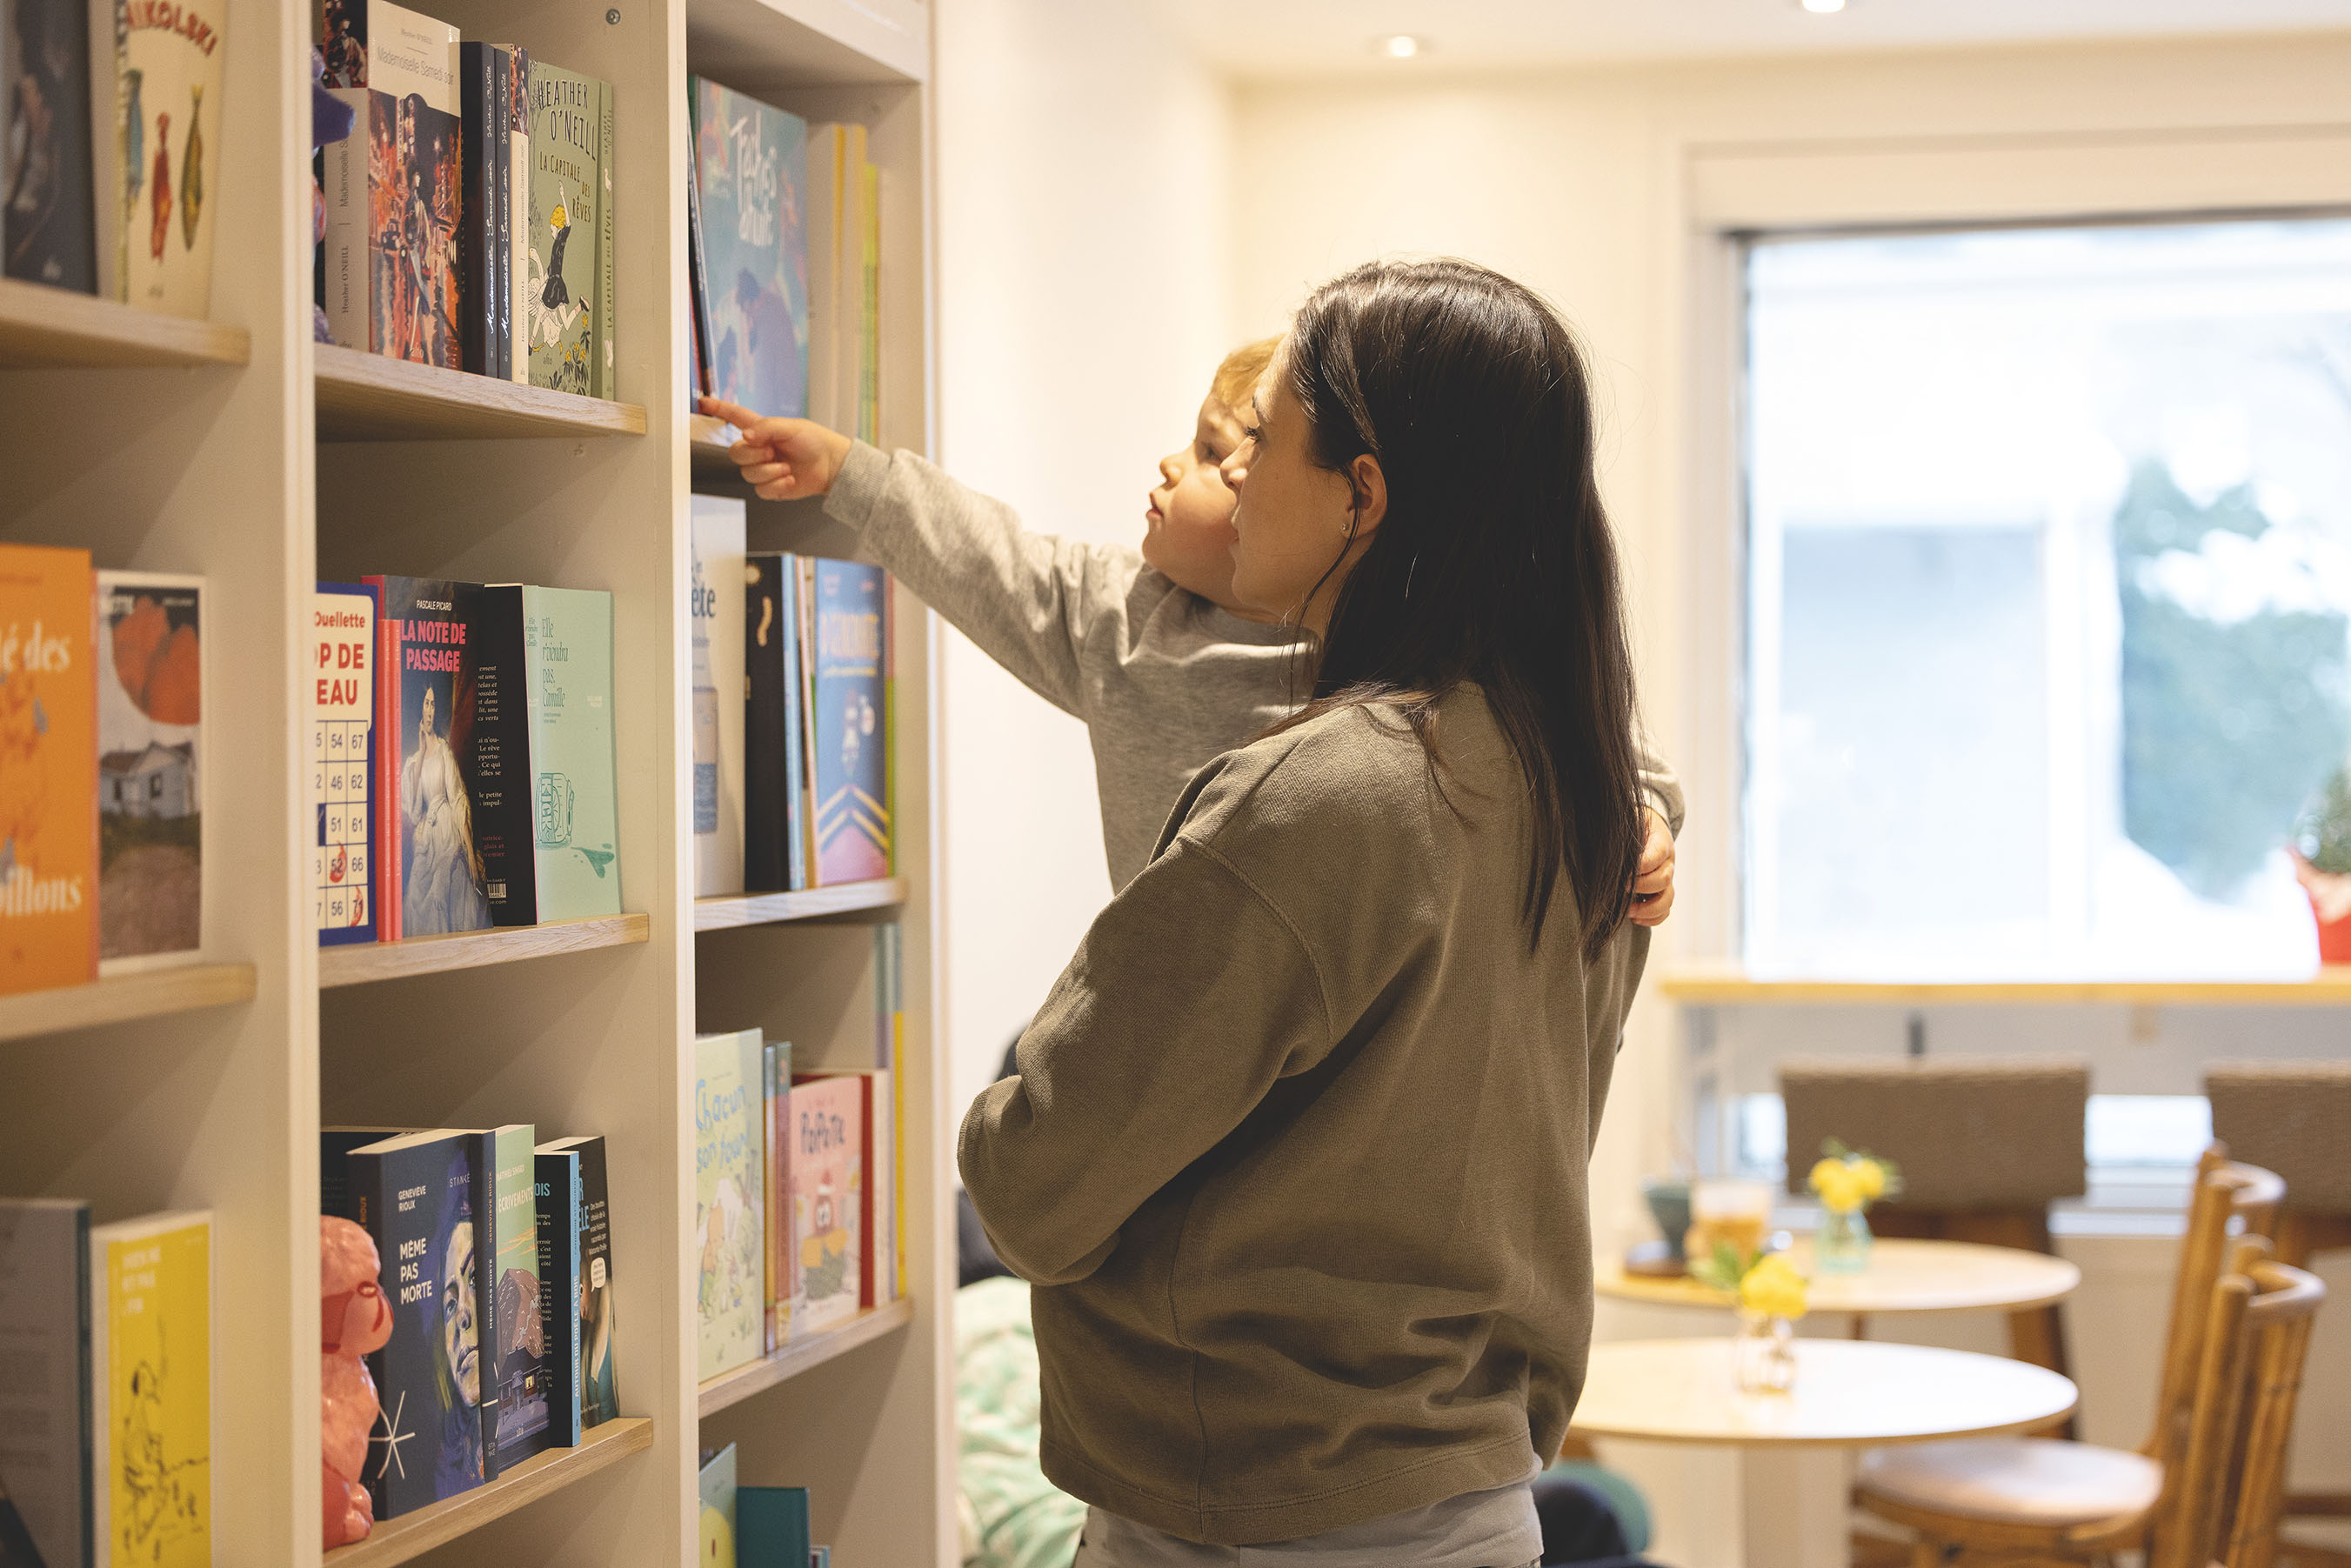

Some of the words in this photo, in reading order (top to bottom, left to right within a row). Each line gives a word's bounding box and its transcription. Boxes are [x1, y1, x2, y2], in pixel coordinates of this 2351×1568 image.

[377, 46, 419, 74] Mademoiselle
[421, 61, 443, 82] Samedi
[537, 79, 588, 110] HEATHER
[550, 110, 596, 161] O'NEILL
[539, 151, 548, 172] LA
[550, 155, 580, 183] CAPITALE
[581, 181, 591, 198] DES
[500, 190, 509, 242] Samedi
[572, 195, 591, 224] RÊVES
[543, 353, 552, 365] alto
[417, 599, 436, 611] PASCALE
[437, 601, 452, 611] PICARD
[401, 619, 416, 642] LA
[417, 620, 449, 644] NOTE
[451, 623, 467, 644] DE
[543, 617, 554, 638] Elle
[24, 620, 70, 671] des
[314, 643, 331, 669] P
[338, 644, 364, 669] DE
[406, 648, 460, 672] PASSAGE
[317, 679, 357, 705] EAU
[543, 686, 565, 708] Camille
[331, 733, 343, 749] 54
[351, 734, 364, 750] 67
[331, 775, 343, 790] 46
[351, 775, 364, 789] 62
[331, 817, 342, 832] 51
[351, 817, 363, 832] 61
[331, 857, 344, 874] 52
[351, 857, 364, 872] 66
[331, 901, 344, 916] 56
[353, 899, 364, 914] 71
[696, 1079, 745, 1131] Chacun
[696, 1142, 718, 1172] son
[449, 1173, 471, 1188] STANKÉ
[535, 1183, 550, 1197] OIS
[398, 1185, 426, 1201] GENEVIÈVE
[498, 1185, 534, 1213] ÉCRIVEMENTS
[398, 1199, 417, 1212] RIOUX
[399, 1237, 427, 1260] MÊME
[400, 1262, 418, 1283] PAS
[400, 1280, 432, 1304] MORTE
[574, 1344, 579, 1357] DU
